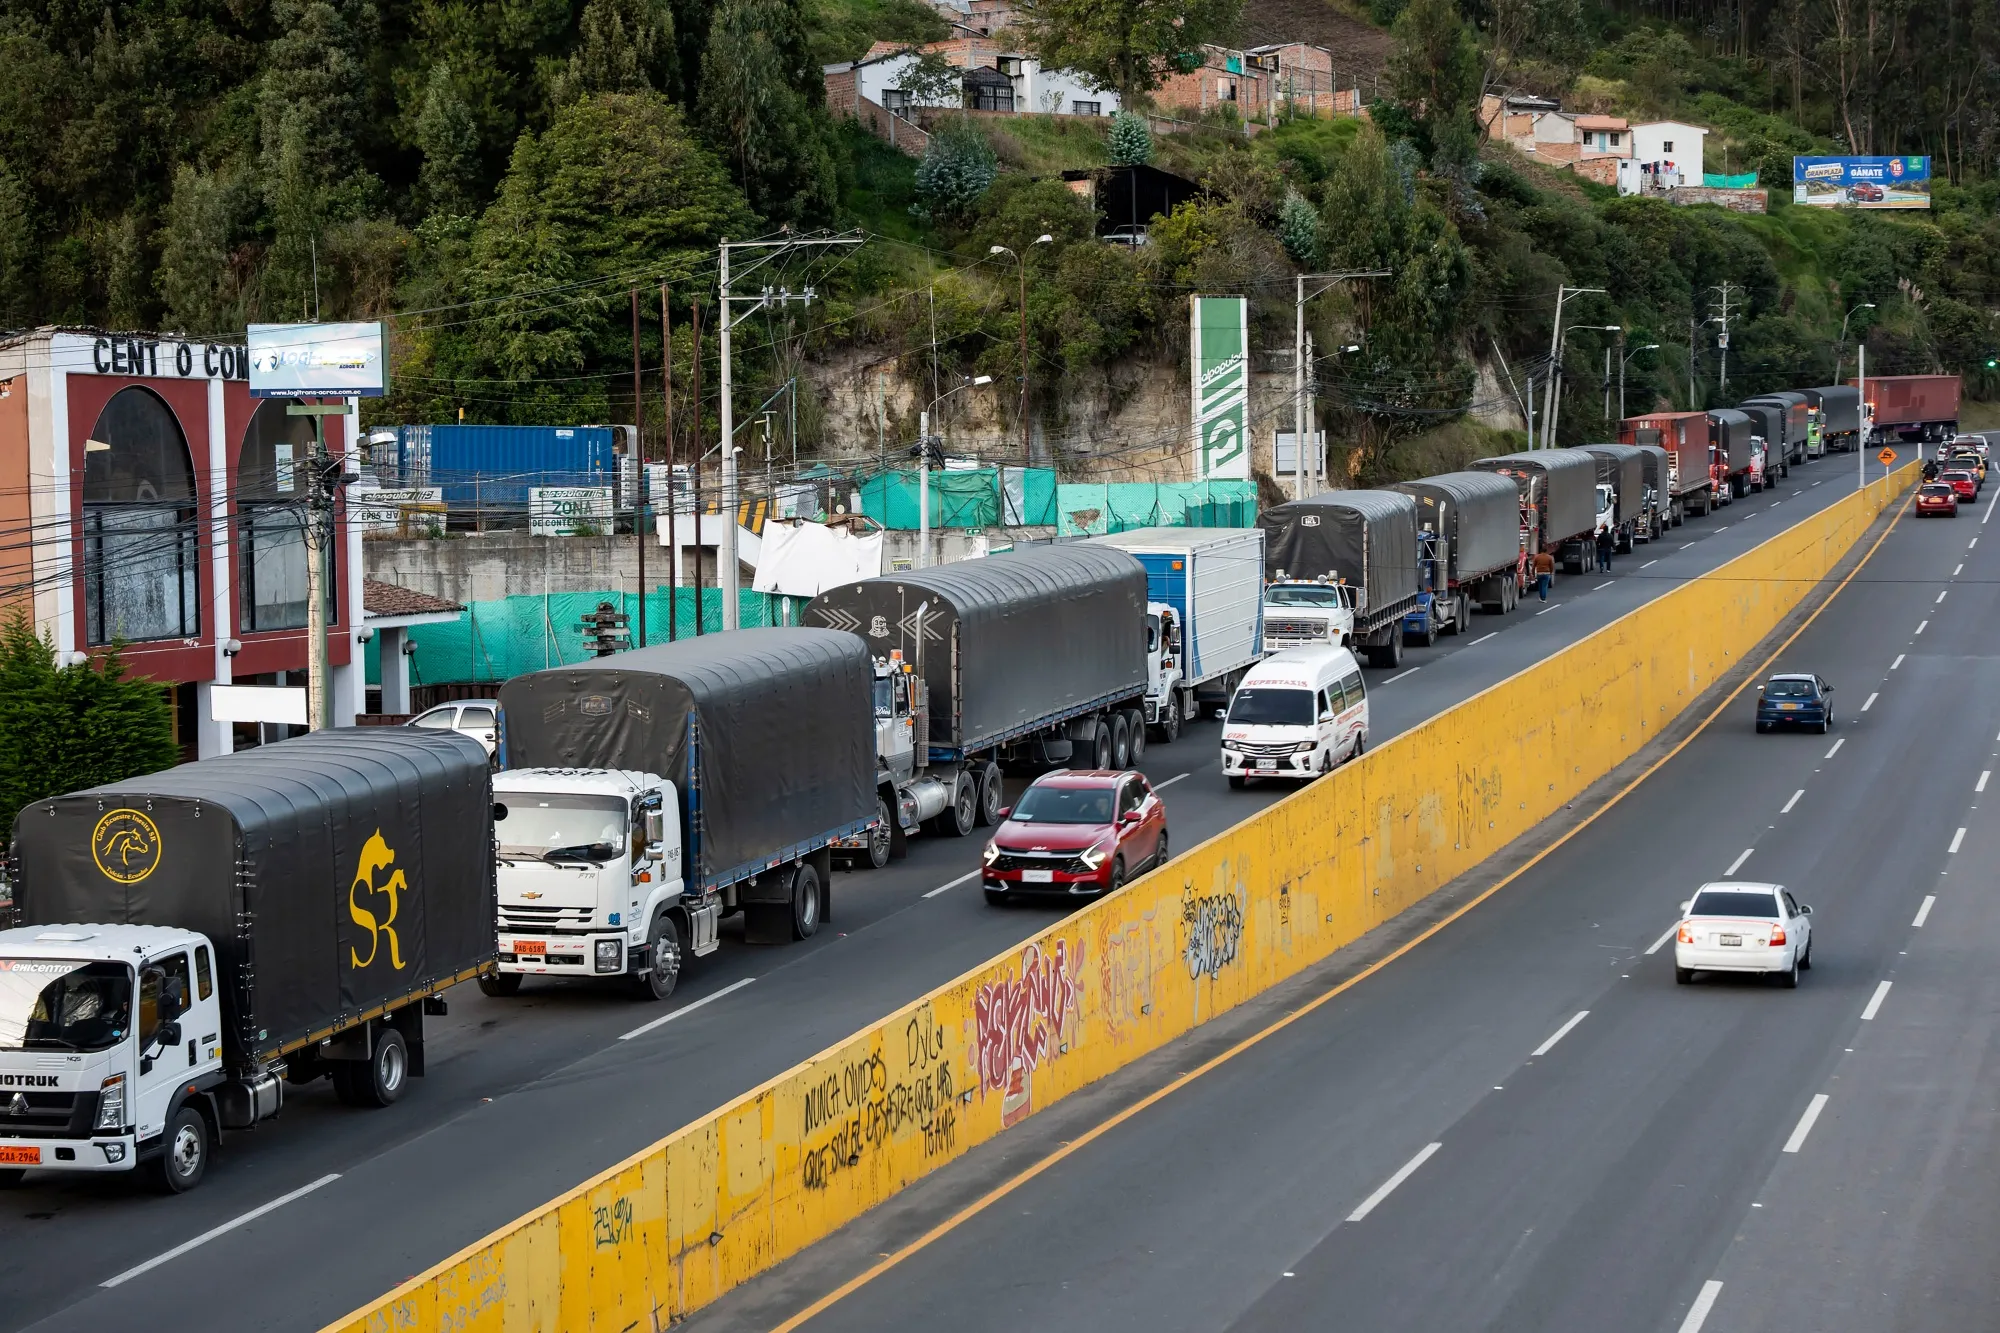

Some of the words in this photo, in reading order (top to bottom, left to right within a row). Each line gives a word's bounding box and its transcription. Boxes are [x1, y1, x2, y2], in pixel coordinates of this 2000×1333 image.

[1850, 166, 1883, 177] GÁNATE
[1201, 352, 1244, 383] alpopular
[552, 500, 593, 515] ZONA
[1244, 679, 1309, 687] SUPERTAXIS
[96, 826, 107, 842] Club
[104, 814, 131, 827] Ecuestre
[132, 814, 151, 832] Inesita
[804, 1072, 840, 1136] NUNCA
